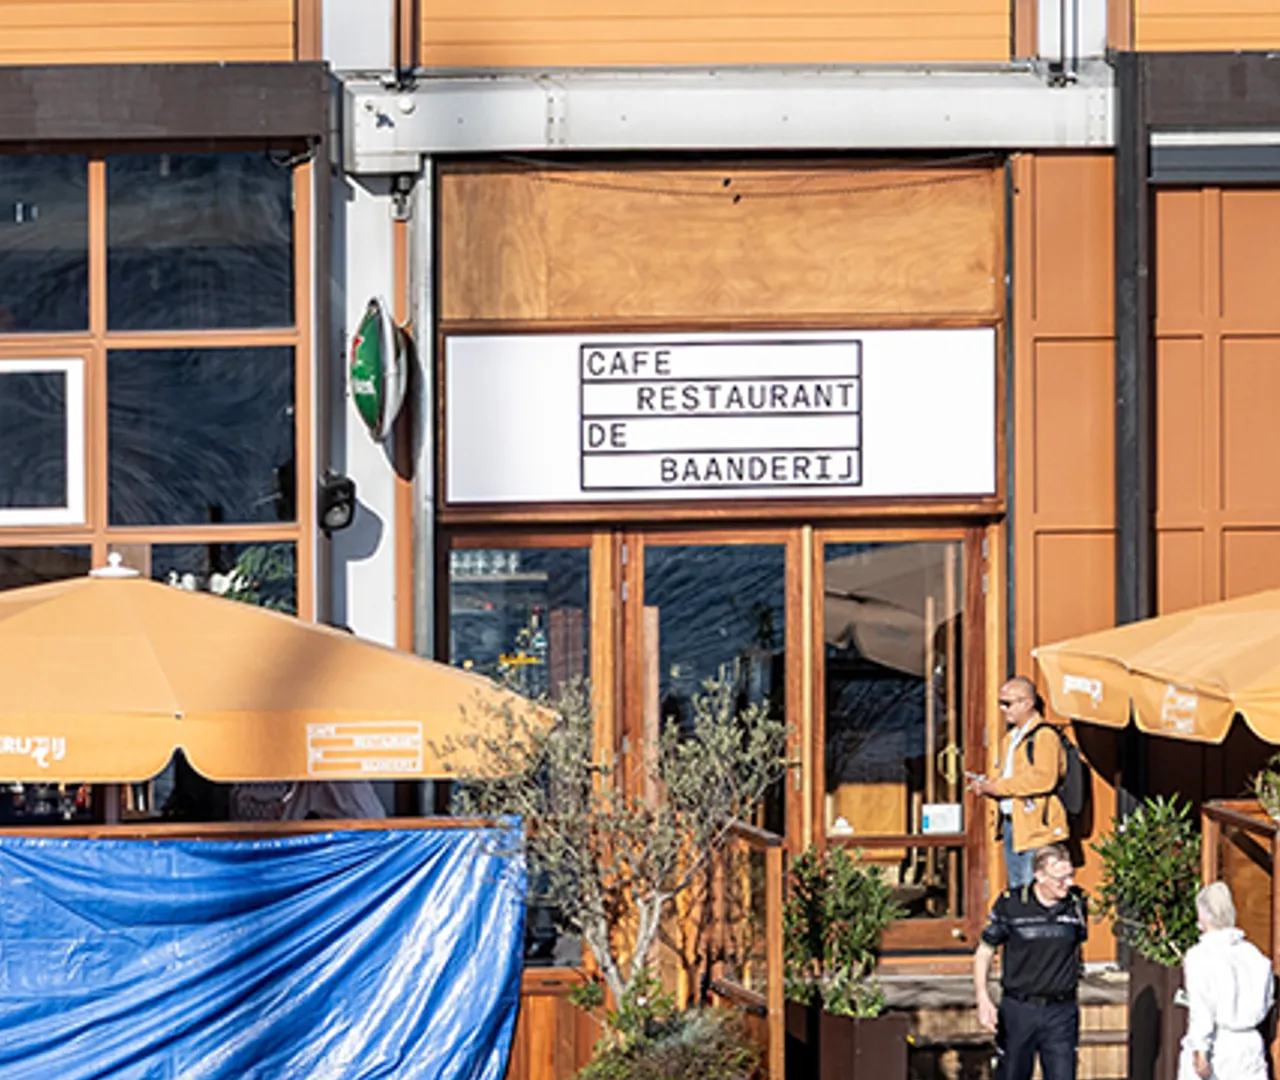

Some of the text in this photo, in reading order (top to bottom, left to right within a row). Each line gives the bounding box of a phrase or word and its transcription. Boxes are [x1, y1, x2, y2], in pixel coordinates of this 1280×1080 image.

[586, 350, 672, 376] CAFE
[636, 384, 854, 411] RESTAURANT
[587, 423, 627, 448] DE
[659, 455, 854, 482] BAANDERIJ
